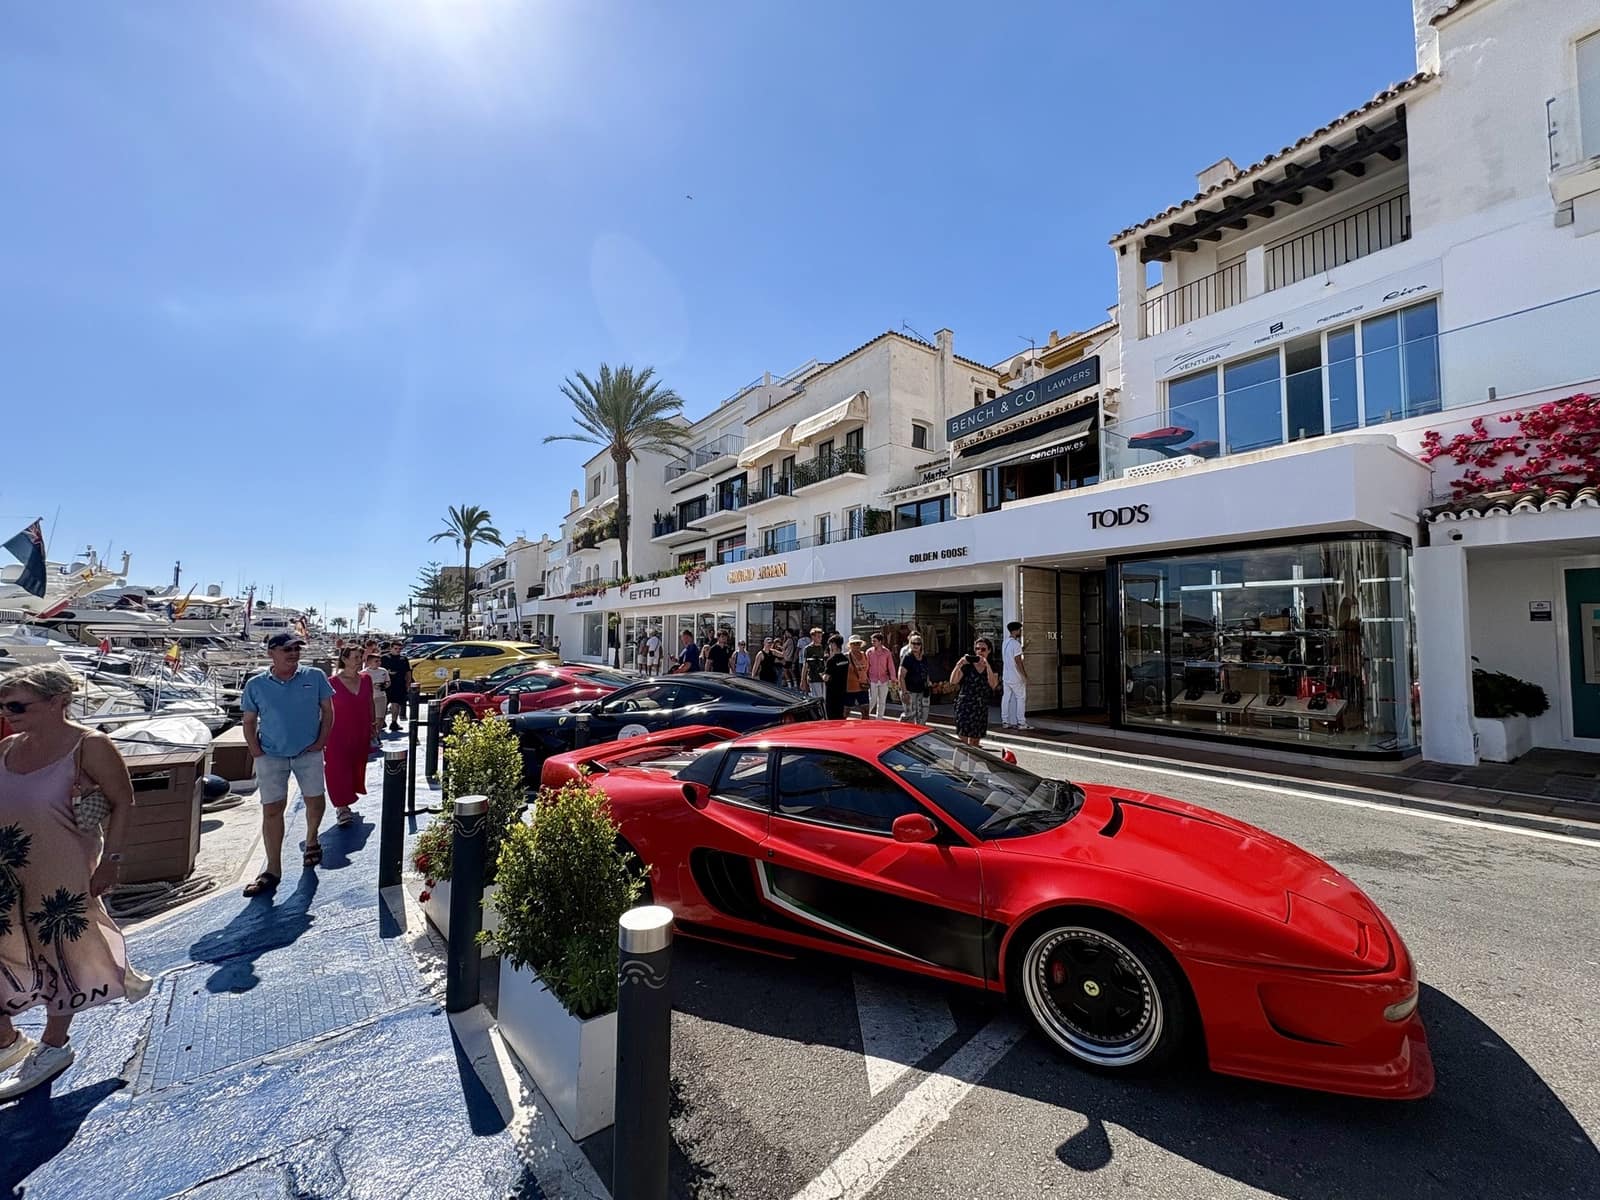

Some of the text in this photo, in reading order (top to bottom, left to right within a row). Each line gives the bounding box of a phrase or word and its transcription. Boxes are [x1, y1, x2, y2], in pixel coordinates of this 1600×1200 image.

[1383, 285, 1428, 302] Riva
[1179, 353, 1221, 370] VENTURA
[951, 368, 1091, 434] BENCH & CO LAWYERS
[1030, 440, 1085, 460] benchlaw.es
[1087, 503, 1150, 530] TOD'S
[909, 546, 968, 564] GOLDEN GOOSE
[629, 587, 660, 600] ETRO
